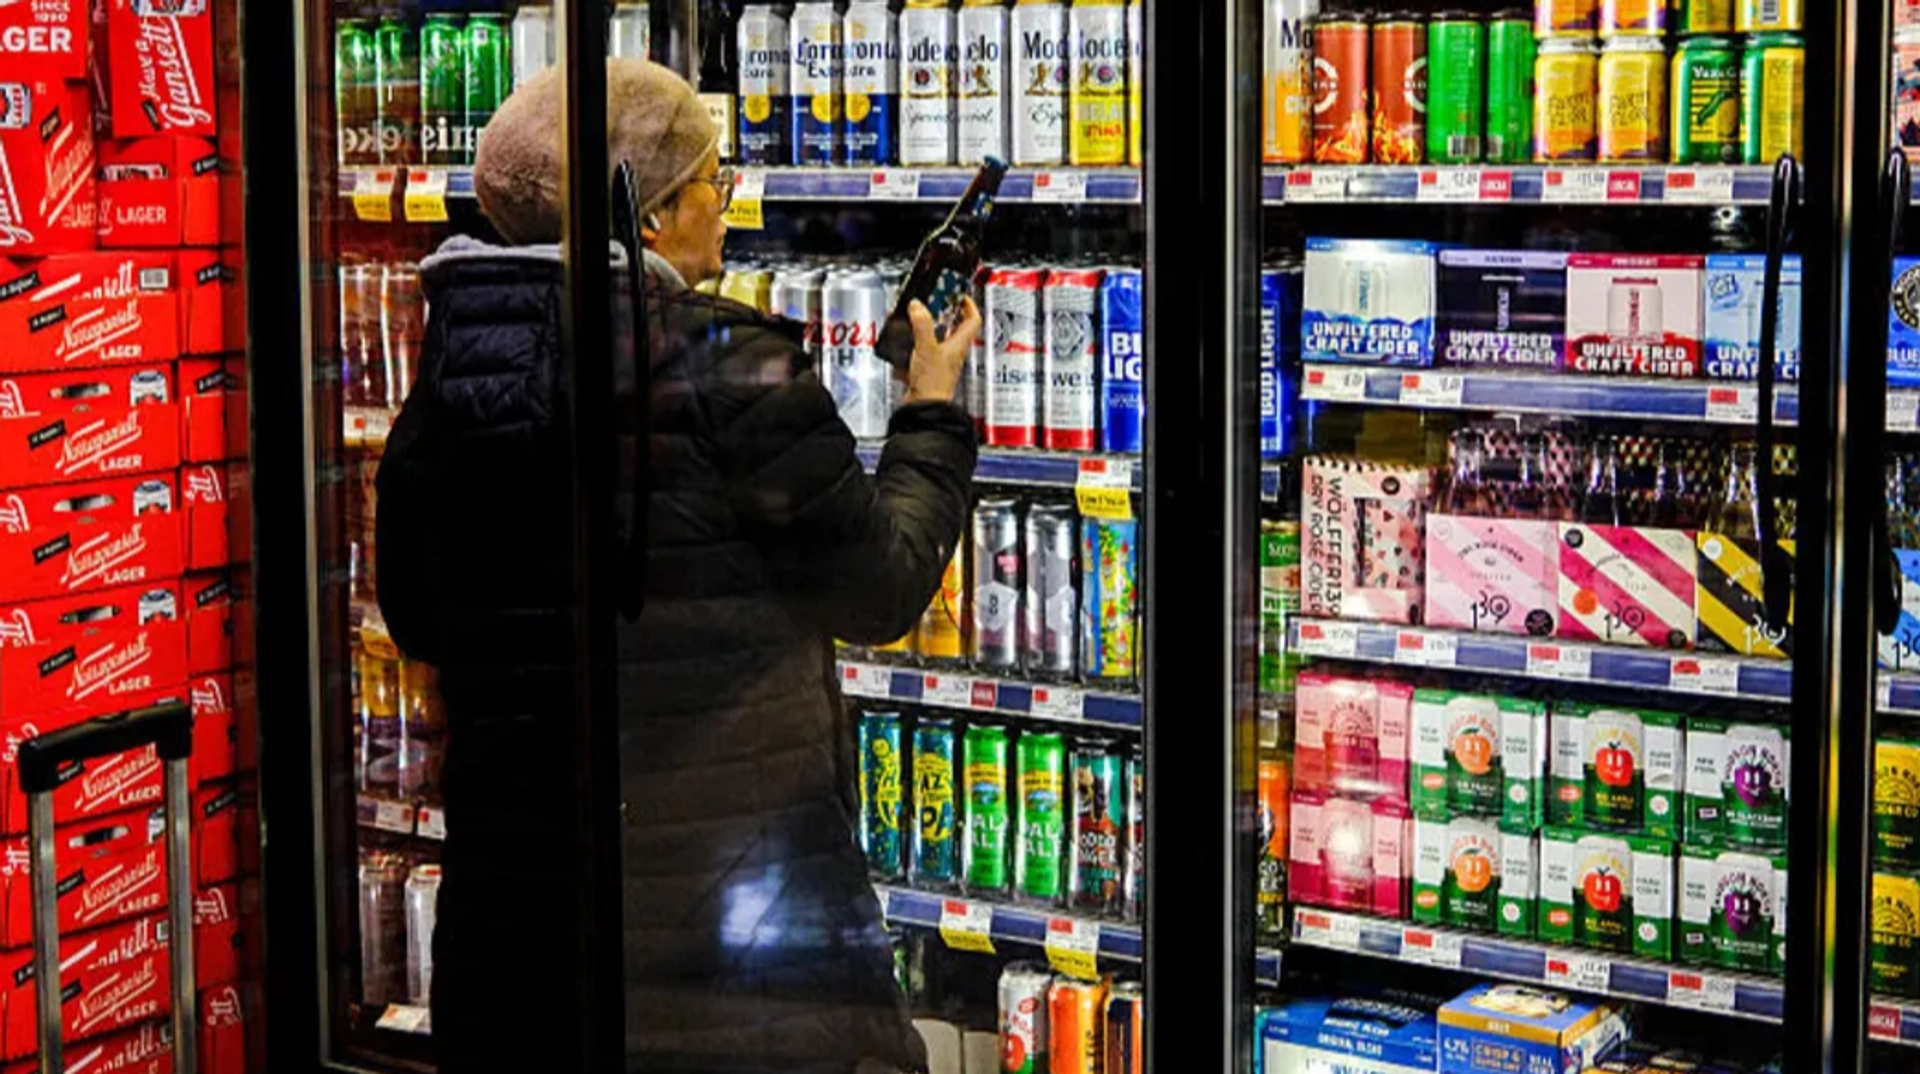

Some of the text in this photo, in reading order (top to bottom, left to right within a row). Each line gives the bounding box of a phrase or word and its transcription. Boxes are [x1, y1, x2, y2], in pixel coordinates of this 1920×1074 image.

[0, 27, 72, 52] GER
[116, 206, 167, 223] LAGER
[1312, 321, 1413, 340] UNFILTERED
[1305, 337, 1420, 355] CRAFT CIDER
[1450, 331, 1552, 349] UNFILTERED
[101, 345, 142, 359] LAGER
[1260, 305, 1275, 417] BUD LIGHT
[1446, 346, 1557, 365] CRAFT CIDER
[1582, 343, 1687, 361] UNFILTERED
[1574, 358, 1694, 376] CRAFT CIDER
[101, 455, 142, 471] LAGER
[1308, 475, 1324, 507] DRY
[1326, 475, 1347, 616] WÖLFFER139
[103, 566, 146, 584] LAGER
